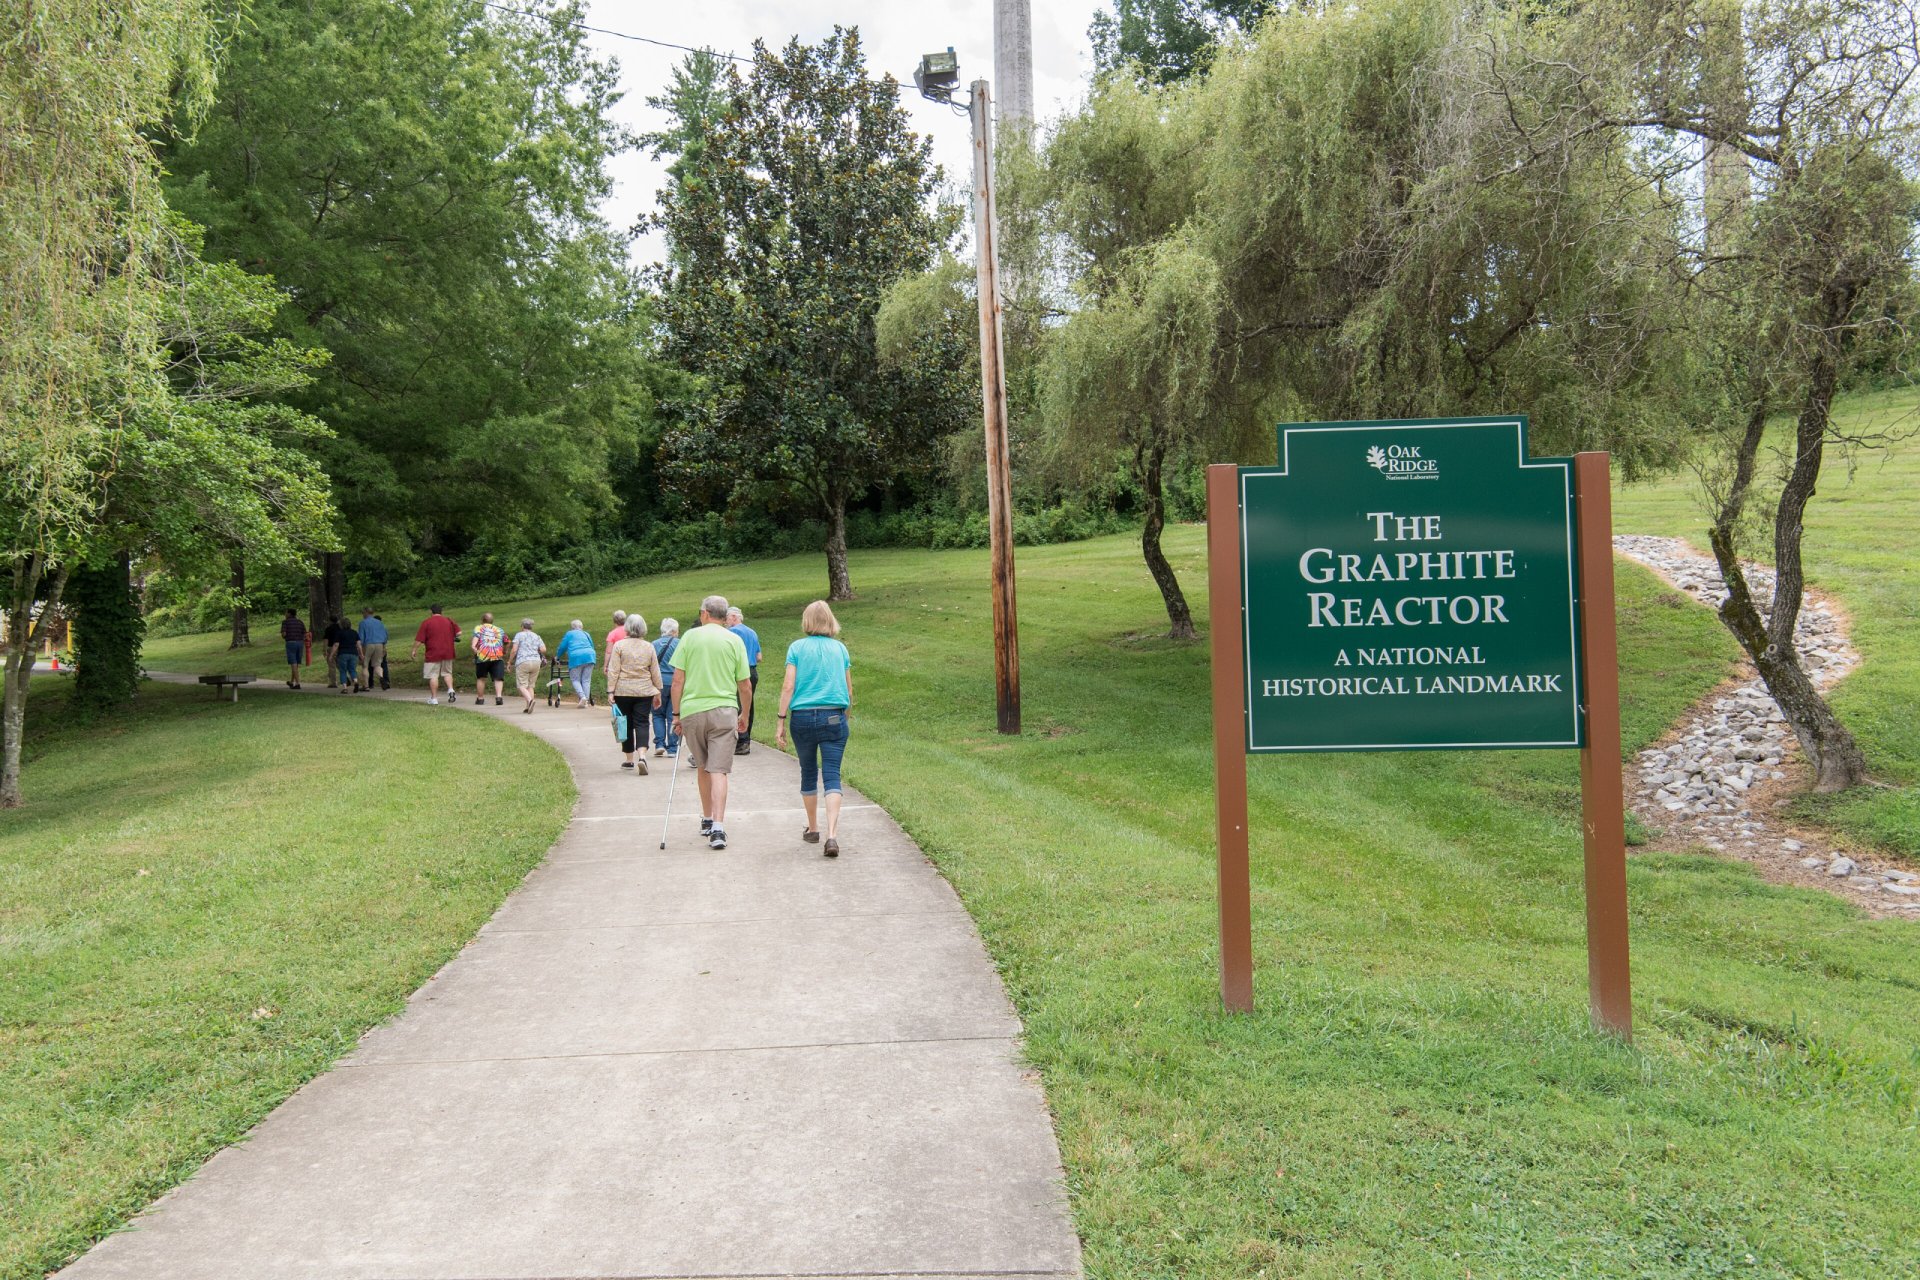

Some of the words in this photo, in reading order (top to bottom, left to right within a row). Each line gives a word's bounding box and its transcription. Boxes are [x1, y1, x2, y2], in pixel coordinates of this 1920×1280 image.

[1387, 444, 1421, 458] OAK
[1388, 458, 1438, 472] RIDGE
[1366, 511, 1442, 542] THE
[1299, 547, 1516, 584] GRAPHITE
[1307, 592, 1510, 628] REACTOR
[1334, 648, 1352, 667] A
[1357, 646, 1486, 666] NATIONAL
[1262, 676, 1410, 697] HISTORICAL
[1415, 674, 1563, 695] LANDMARK
